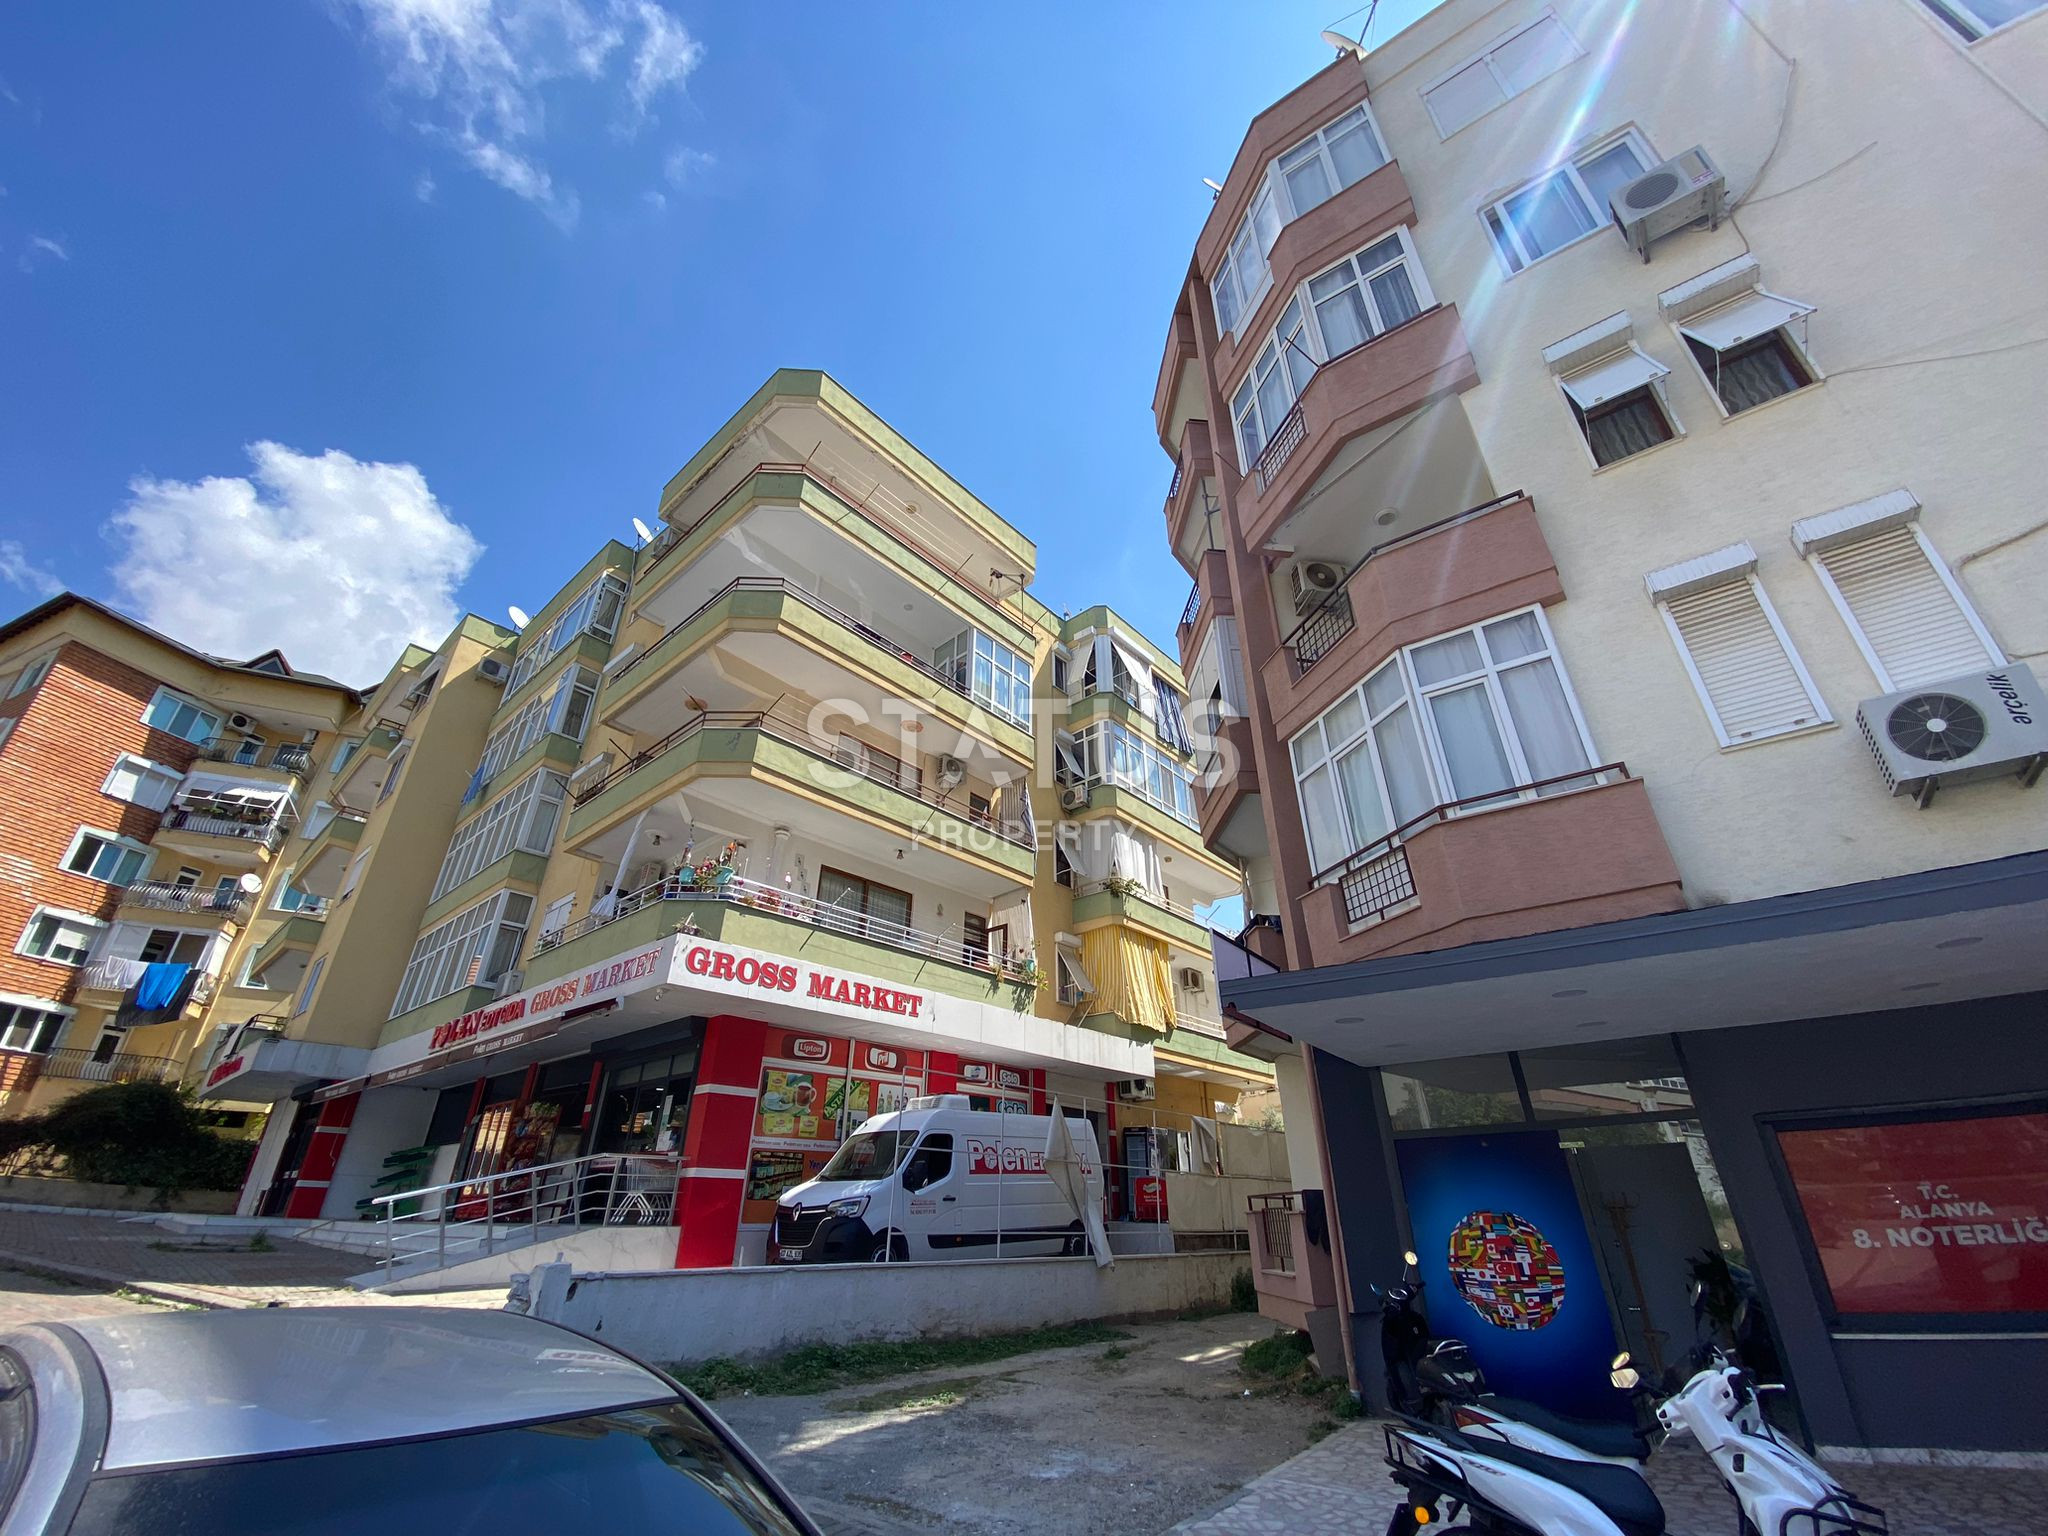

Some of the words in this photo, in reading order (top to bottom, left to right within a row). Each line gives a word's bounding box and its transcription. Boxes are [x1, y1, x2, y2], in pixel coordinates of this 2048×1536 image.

[530, 977, 580, 1014] GROSS
[580, 947, 663, 997] MARKET
[686, 946, 798, 992] GROSS
[806, 972, 923, 1018] MARKET
[799, 1041, 822, 1053] Lipton
[1002, 1071, 1018, 1085] Solo
[1917, 1183, 1960, 1200] T.C.
[1900, 1202, 1994, 1220] ALANYA
[1852, 1228, 1881, 1249] 8.
[1885, 1216, 2048, 1248] NOTERLİĞ
